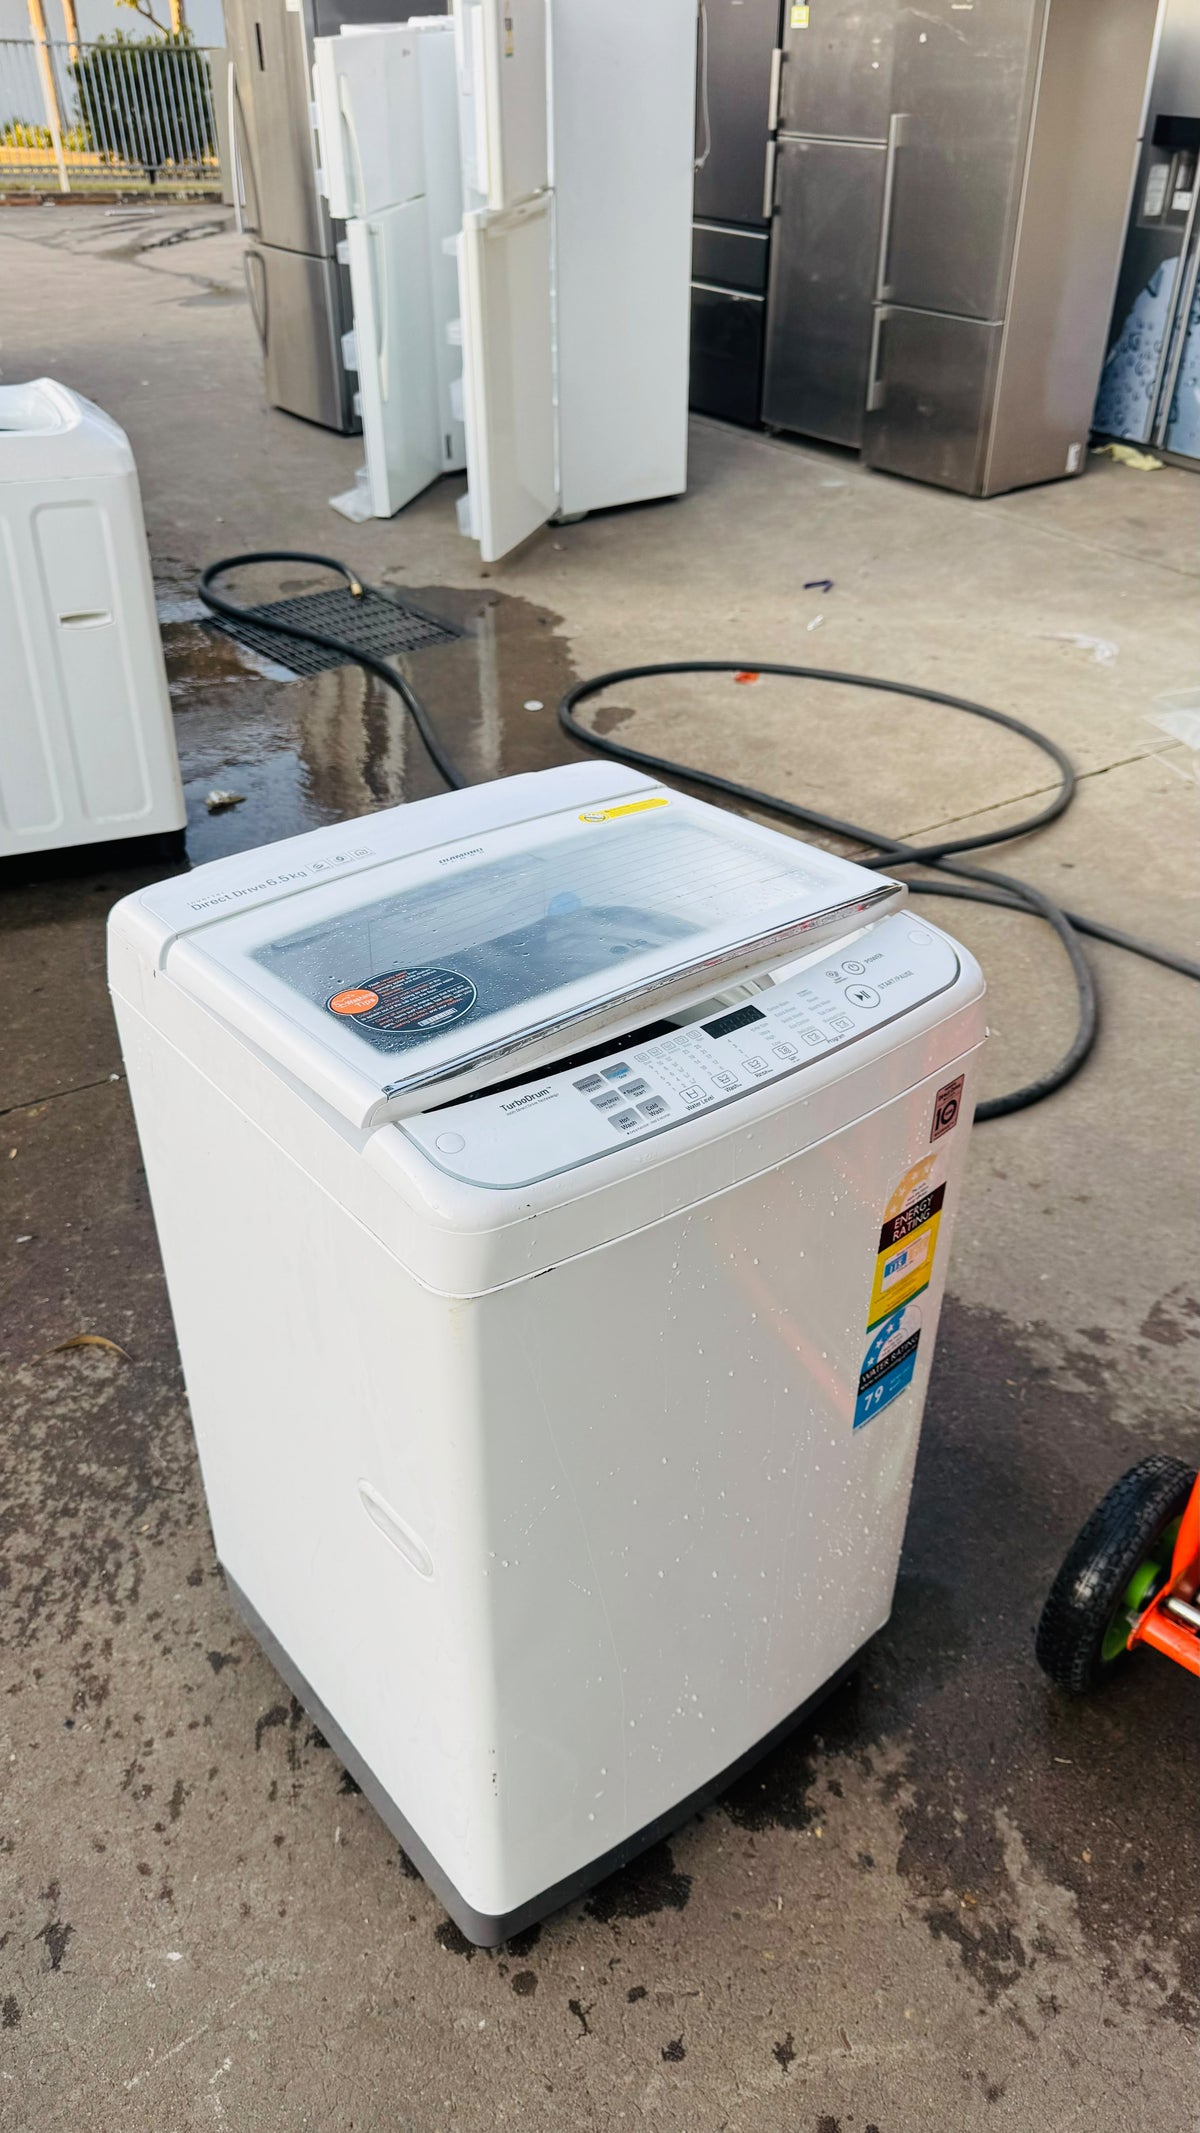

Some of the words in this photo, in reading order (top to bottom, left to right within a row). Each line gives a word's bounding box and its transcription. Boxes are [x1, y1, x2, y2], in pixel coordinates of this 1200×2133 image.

[191, 895, 233, 911] Direct
[232, 884, 267, 898] Drive
[626, 938, 648, 949] LG
[864, 952, 884, 964] POWER
[877, 970, 915, 990] START/PAUSE
[826, 1034, 845, 1044] Program
[577, 1078, 602, 1090] Intensive
[585, 1084, 602, 1094] Wash
[633, 1089, 647, 1097] Start
[645, 1102, 659, 1111] Cold
[685, 1101, 701, 1111] Water
[700, 1095, 715, 1105] Level
[648, 1107, 665, 1117] Wash
[618, 1116, 630, 1125] Hot
[620, 1120, 638, 1131] Wash
[893, 1194, 934, 1231] ENERGY
[892, 1207, 931, 1242] RATING
[861, 1356, 890, 1383] WATER
[891, 1333, 919, 1360] RATING
[864, 1385, 884, 1412] 79
